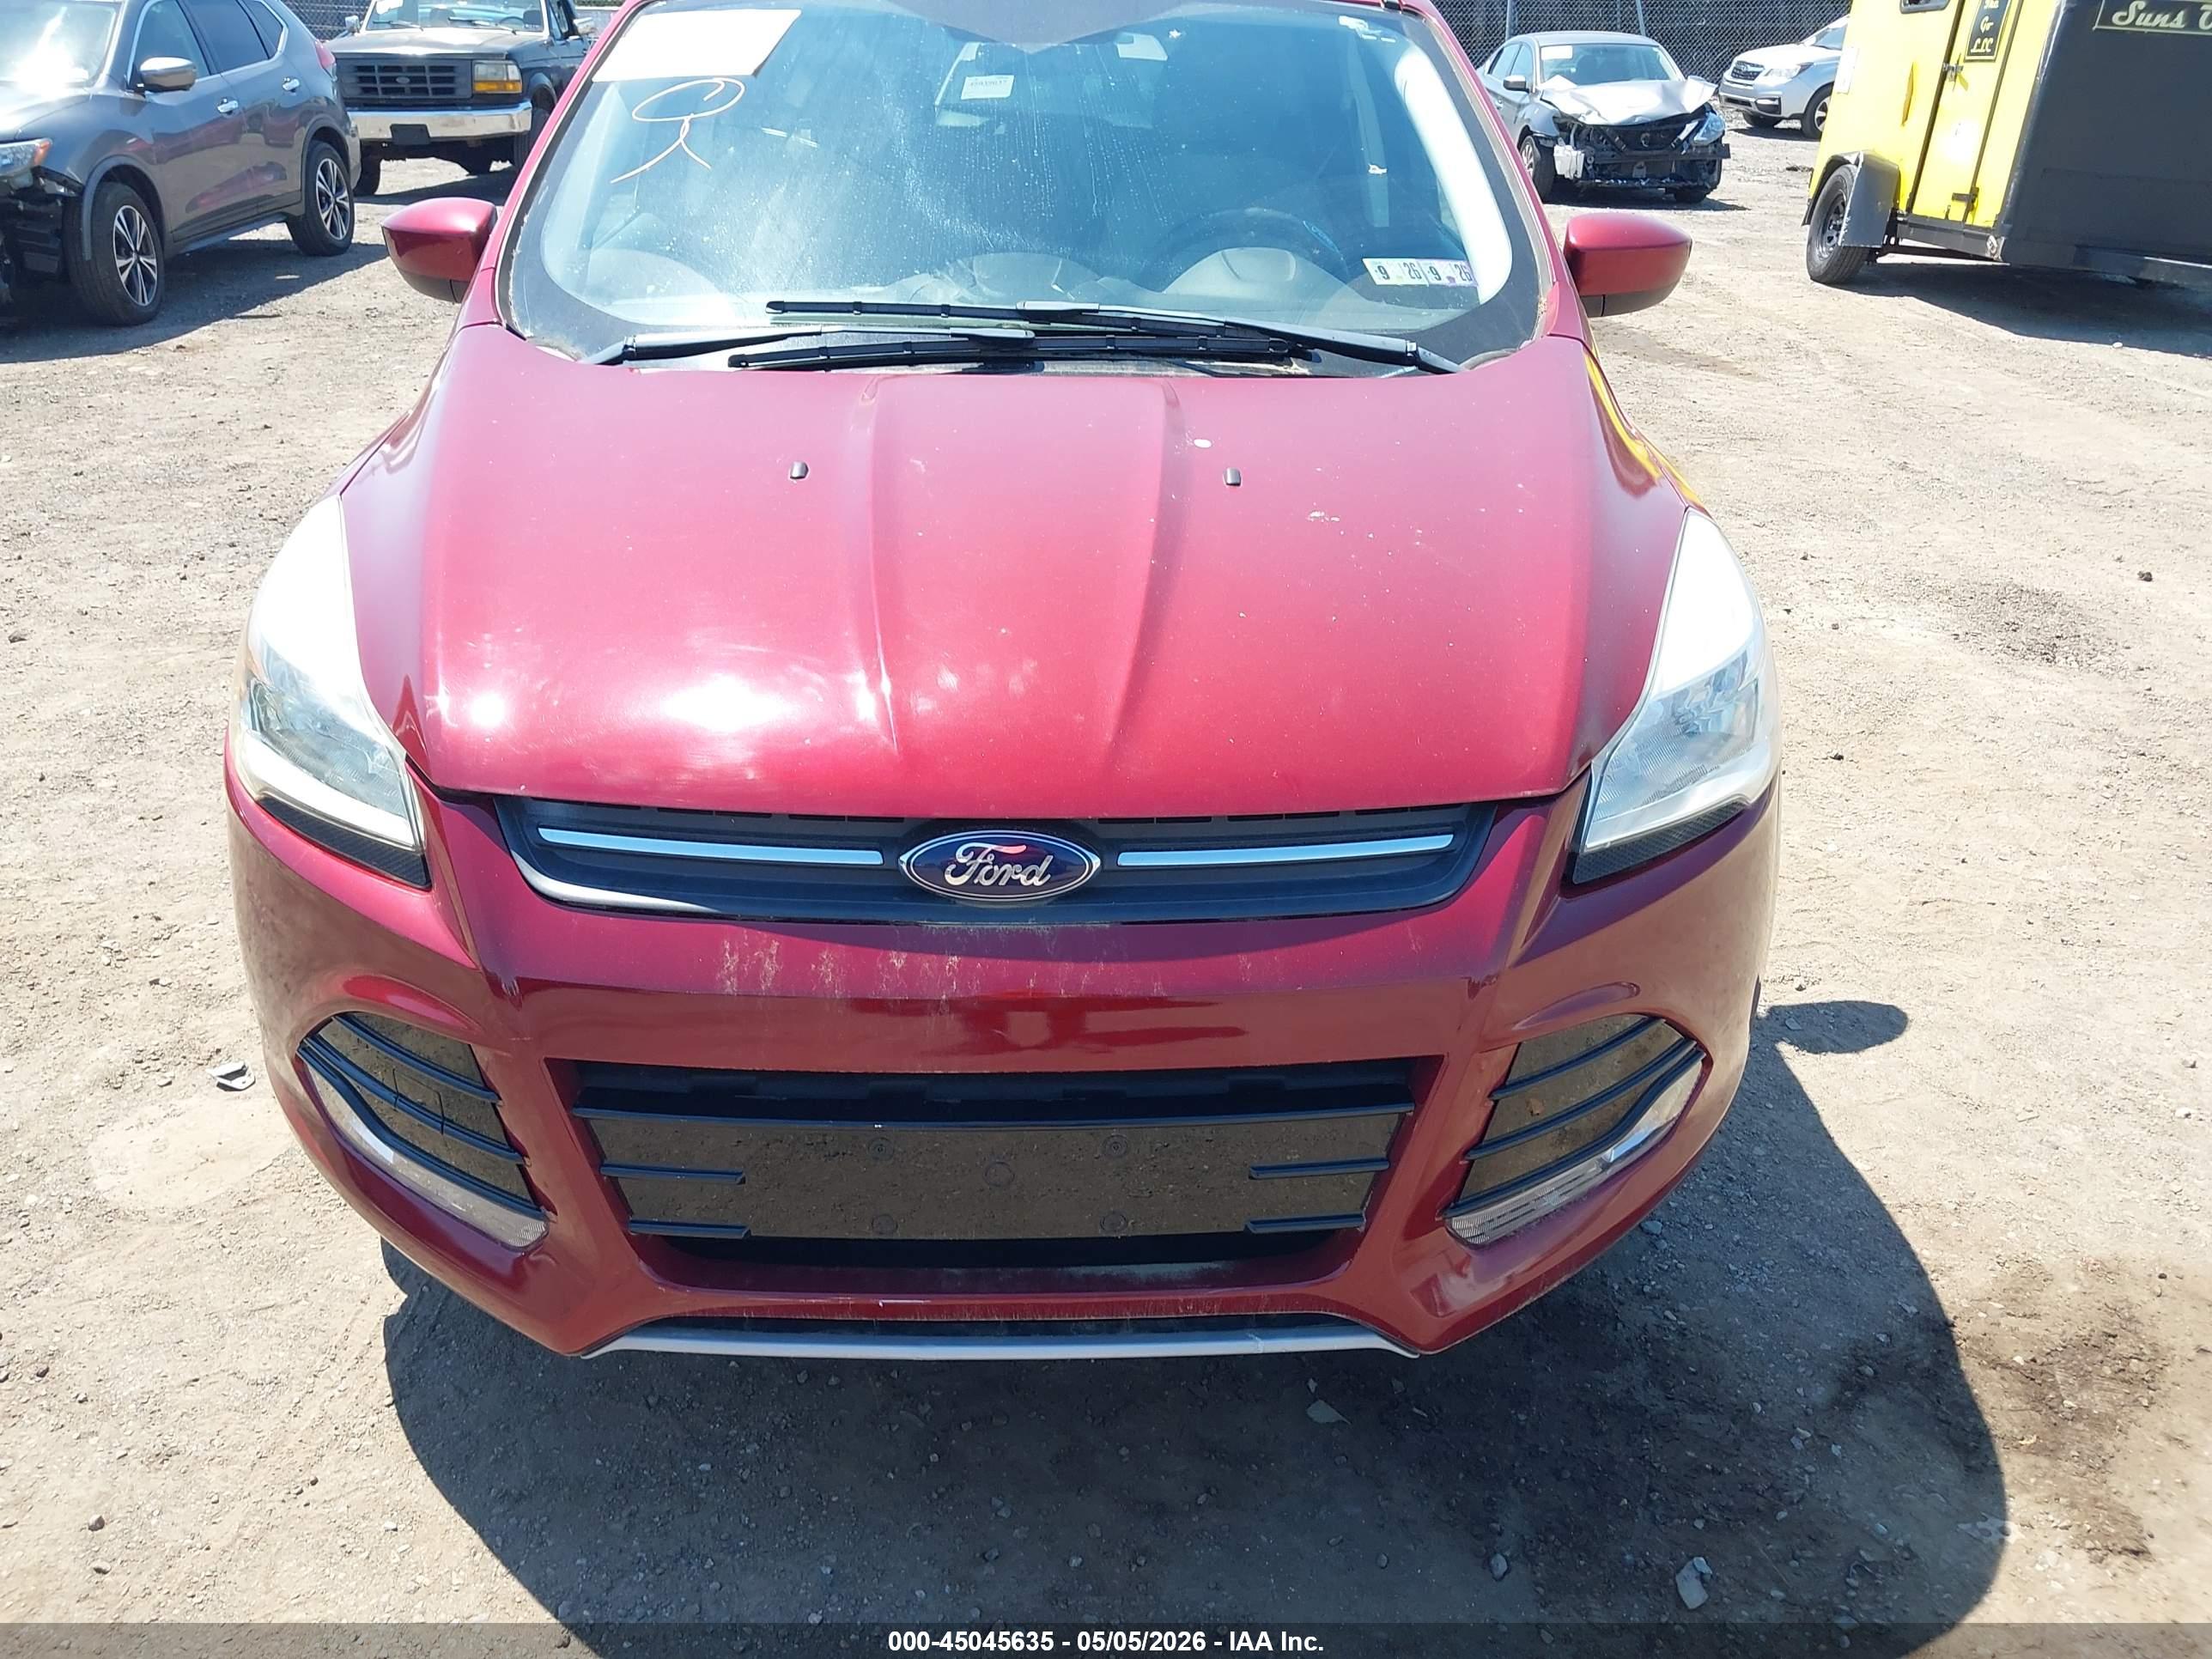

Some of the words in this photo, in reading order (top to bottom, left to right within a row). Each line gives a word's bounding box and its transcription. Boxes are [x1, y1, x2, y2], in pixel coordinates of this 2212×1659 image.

[2112, 0, 2185, 28] Suns
[1980, 15, 1995, 33] Go
[1970, 37, 1994, 53] LLC
[1376, 265, 1390, 280] 9
[1402, 262, 1422, 280] 26
[1429, 266, 1442, 281] 9
[1454, 264, 1473, 282] 26
[945, 842, 1054, 886] Ford
